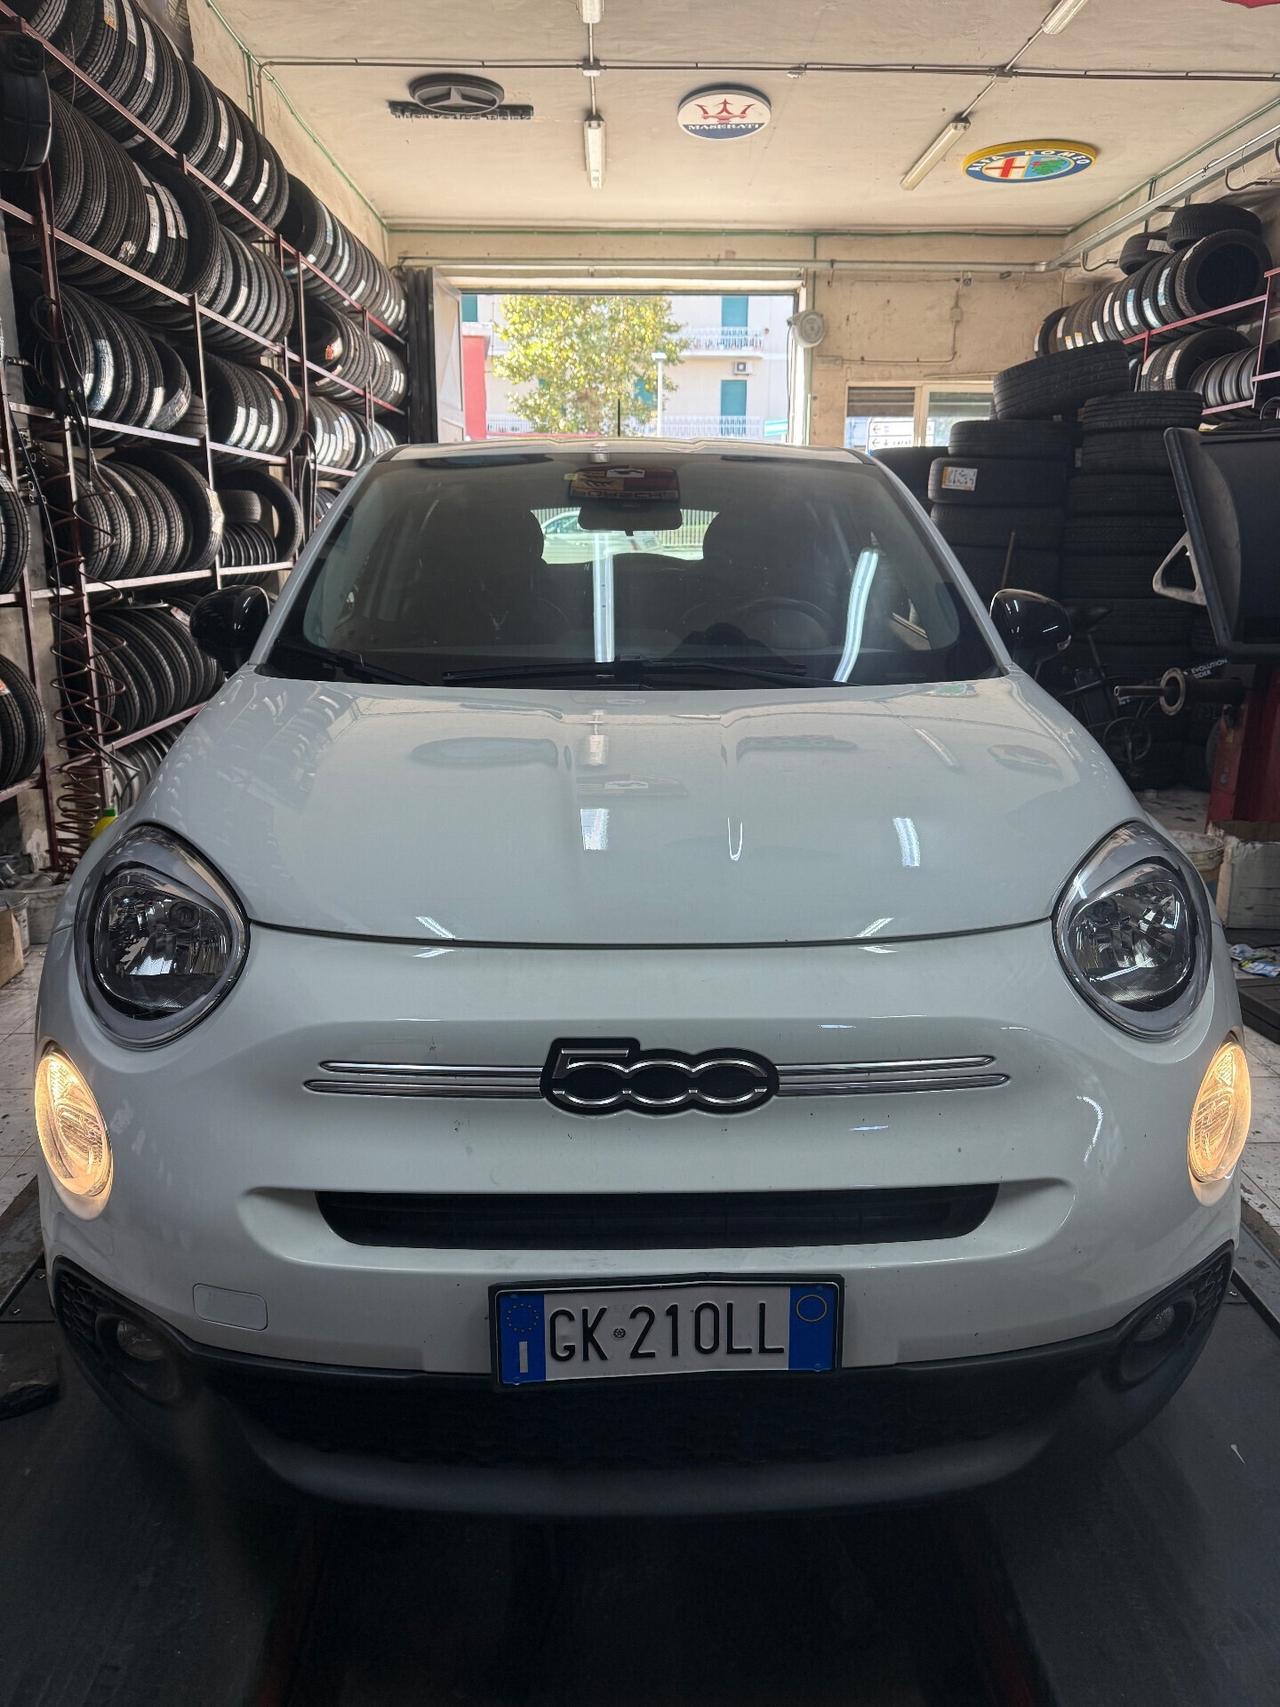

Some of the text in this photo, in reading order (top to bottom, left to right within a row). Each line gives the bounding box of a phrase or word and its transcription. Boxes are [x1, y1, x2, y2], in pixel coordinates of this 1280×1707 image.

[687, 123, 760, 131] MASERATI
[968, 149, 1091, 171] ALFA ROMEO
[550, 1046, 770, 1106] 500
[549, 1306, 609, 1362] GK
[628, 1301, 786, 1359] 210LL
